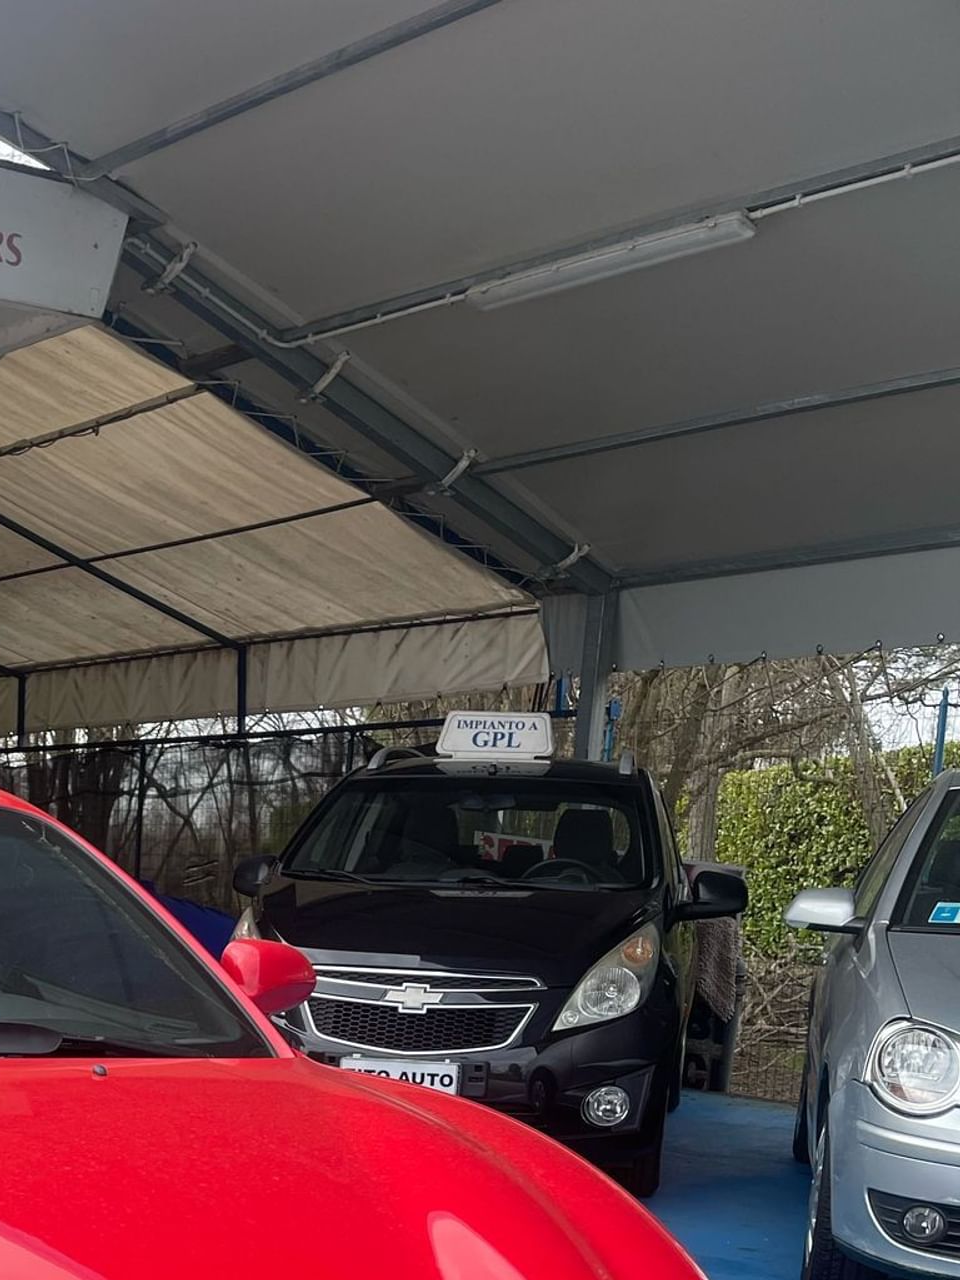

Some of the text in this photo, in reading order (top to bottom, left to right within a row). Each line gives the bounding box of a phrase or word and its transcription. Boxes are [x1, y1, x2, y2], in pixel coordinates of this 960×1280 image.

[457, 719, 538, 731] IMPIANTO A
[471, 731, 521, 749] GPL
[398, 1071, 454, 1088] AUTO
